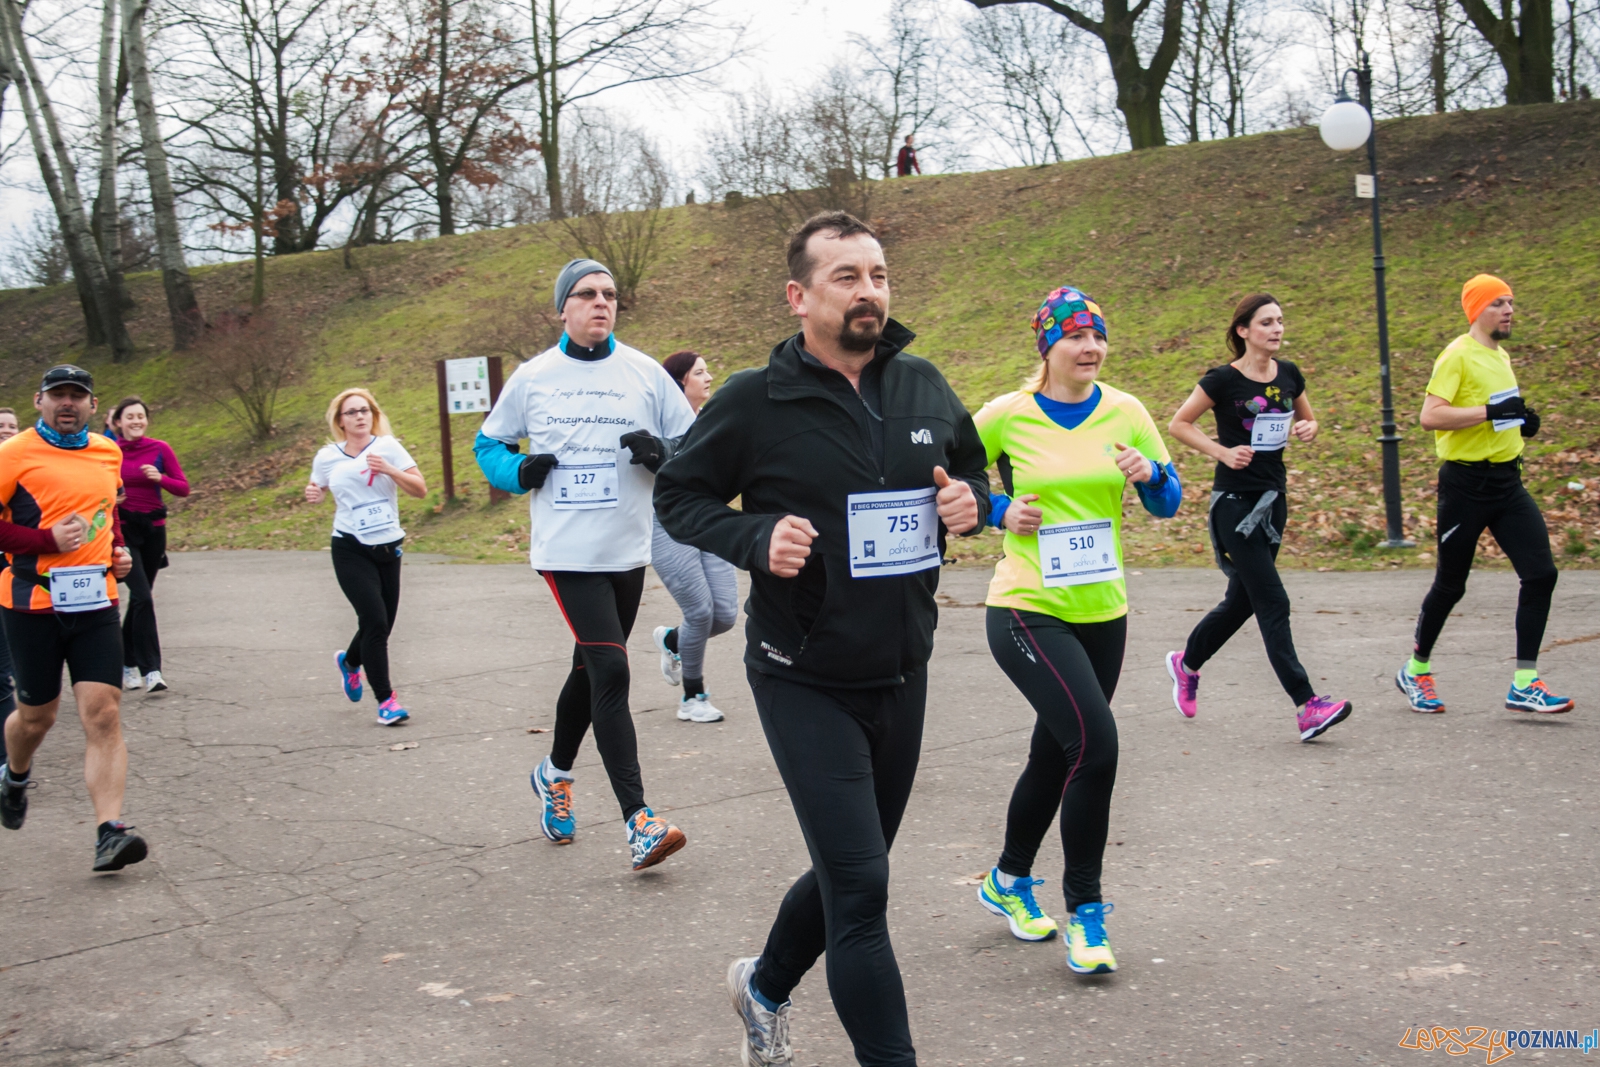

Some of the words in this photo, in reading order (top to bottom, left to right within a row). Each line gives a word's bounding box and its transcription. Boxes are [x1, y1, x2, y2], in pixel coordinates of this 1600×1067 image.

[547, 415, 635, 427] DruzynaJezusa.pl
[1270, 423, 1284, 432] 515
[574, 473, 595, 484] 127
[368, 506, 382, 516] 355
[871, 501, 904, 509] POWSTANIA
[887, 514, 918, 533] 755
[889, 538, 918, 556] parkrun
[1069, 535, 1094, 551] 510
[1073, 554, 1097, 568] parkrun
[73, 577, 91, 589] 667
